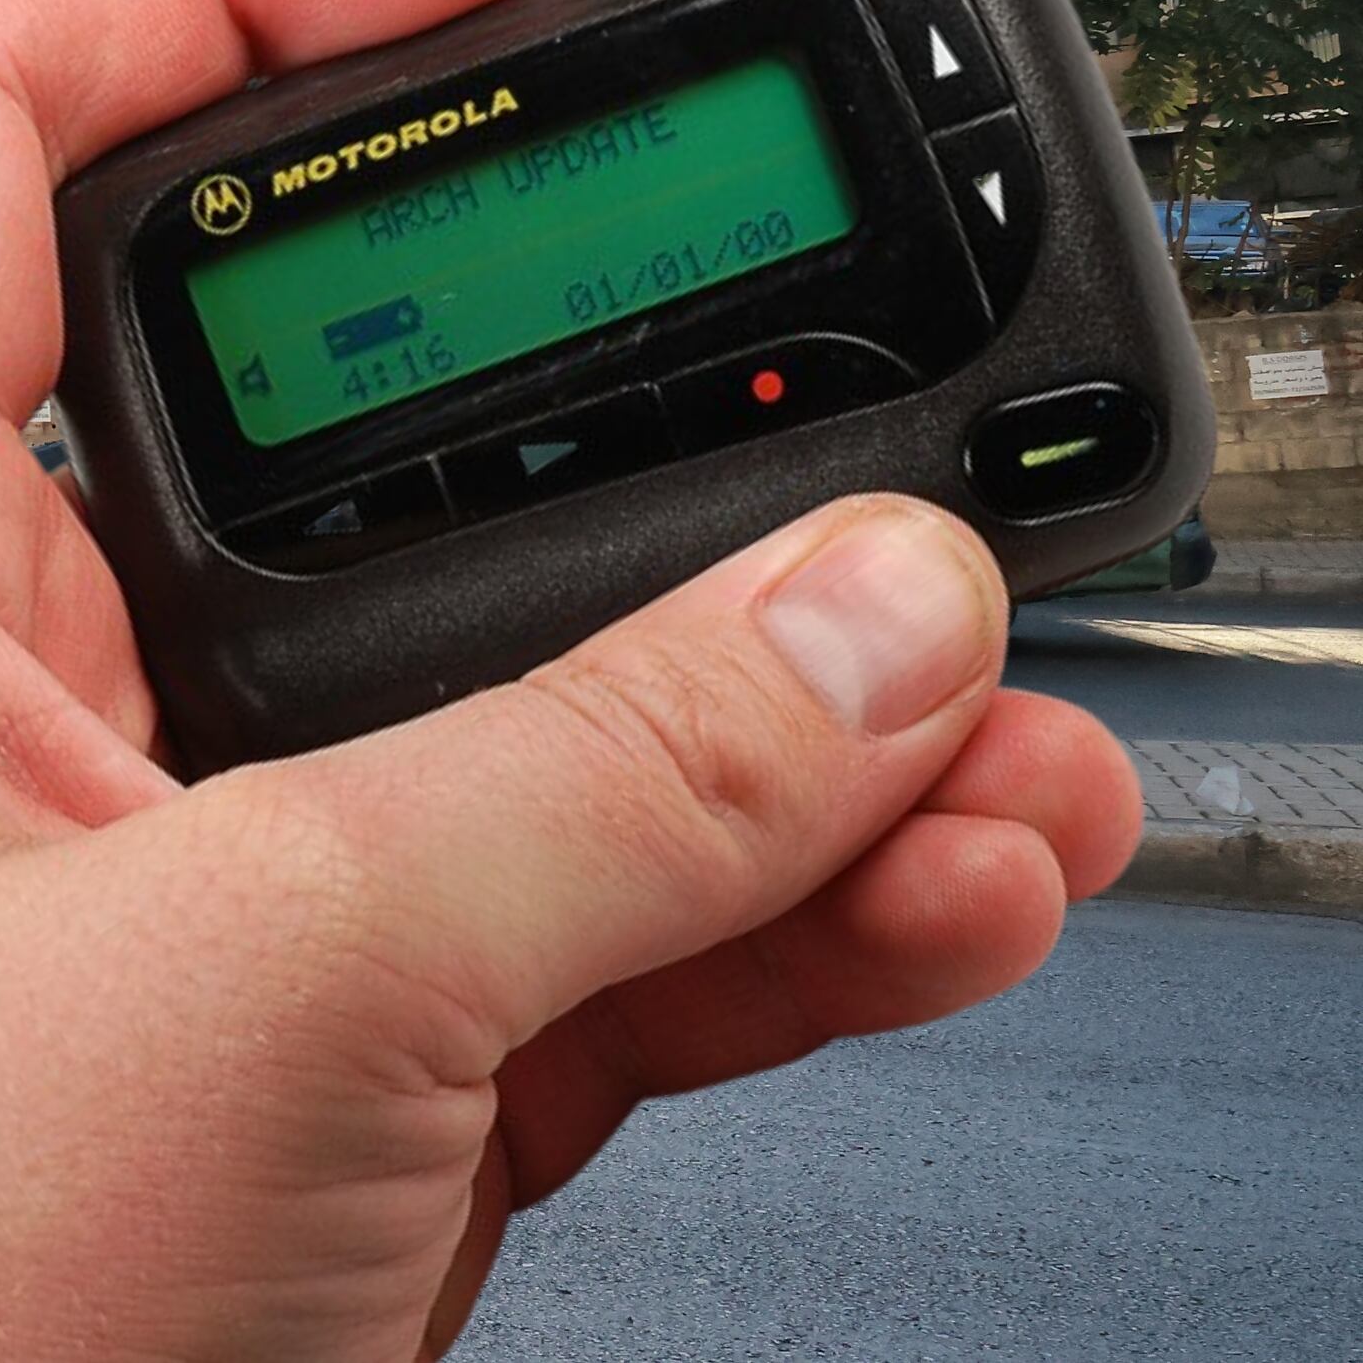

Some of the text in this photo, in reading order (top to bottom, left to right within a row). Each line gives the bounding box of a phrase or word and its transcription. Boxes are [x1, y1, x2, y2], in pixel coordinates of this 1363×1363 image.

[273, 87, 519, 196] MOTOROLA
[360, 102, 678, 248] ARCH UPDATE
[565, 209, 795, 322] 01/01/00
[342, 335, 457, 405] 4:16
